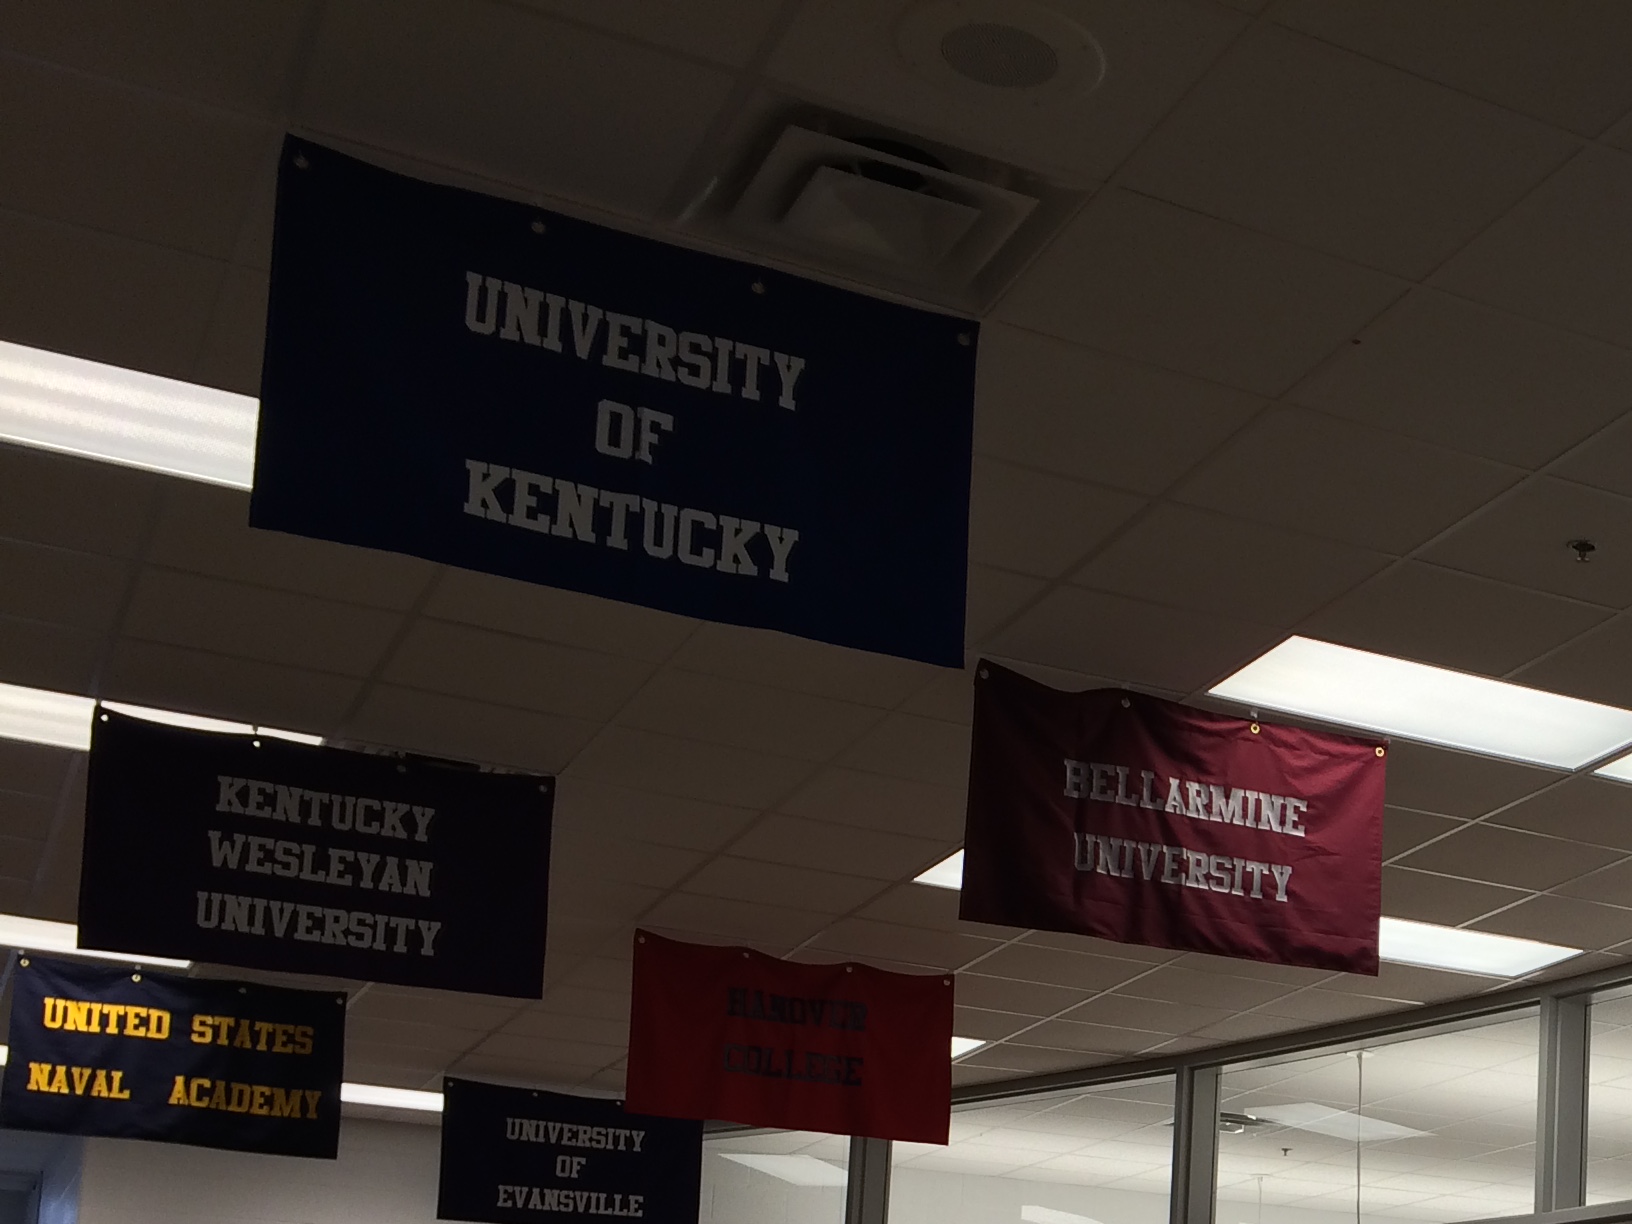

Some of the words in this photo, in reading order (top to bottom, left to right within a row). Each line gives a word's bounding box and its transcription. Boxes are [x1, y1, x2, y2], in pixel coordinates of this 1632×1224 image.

[465, 270, 805, 411] UNIVERSITY
[595, 399, 675, 464] OF
[463, 458, 800, 583] KENTUCKY
[215, 775, 436, 842] KENTUCKY
[1063, 758, 1308, 837] BELLARMINE
[208, 829, 434, 897] WESLEYAN
[1073, 831, 1293, 902] UNIVERSITY
[196, 890, 441, 957] UNIVERSITY
[43, 996, 172, 1041] UNITED
[190, 1013, 315, 1055] STATES
[726, 987, 868, 1032] HANOVER
[26, 1061, 131, 1100] NAVAL
[167, 1074, 322, 1120] ACADEMY
[723, 1043, 864, 1086] COLLEGE
[506, 1117, 646, 1152] UNIVERSITY
[555, 1155, 587, 1178] OF
[496, 1184, 644, 1217] EVANSVILLE
